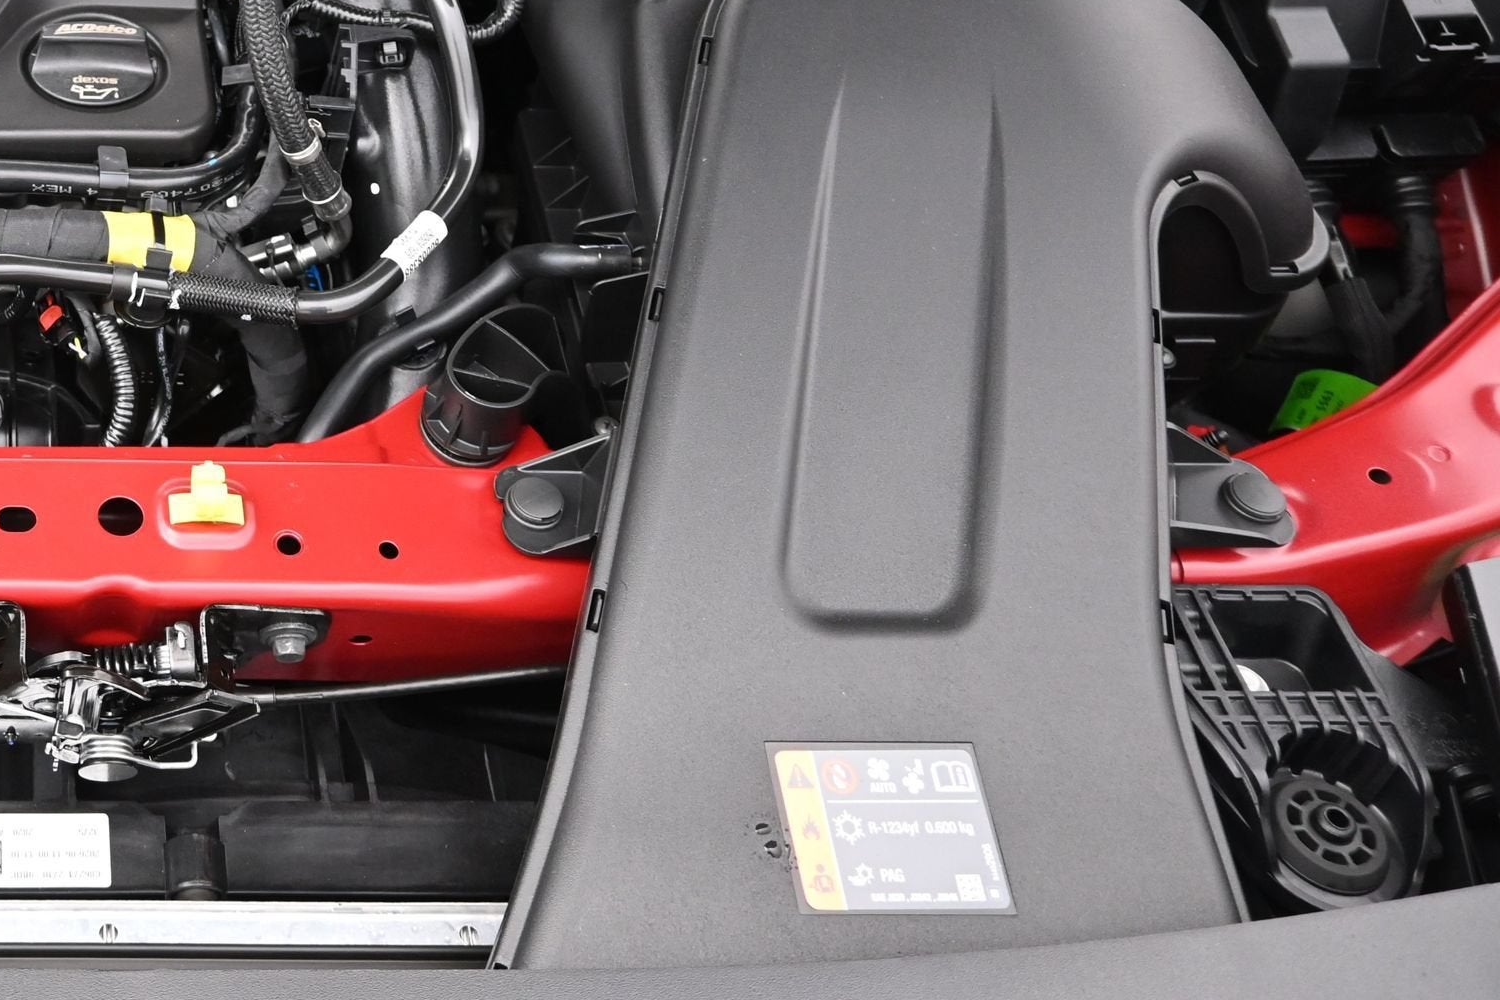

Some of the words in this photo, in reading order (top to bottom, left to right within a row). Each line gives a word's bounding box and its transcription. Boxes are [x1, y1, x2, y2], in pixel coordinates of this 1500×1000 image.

[53, 23, 137, 36] ACDelco
[72, 75, 118, 85] dexos
[32, 182, 73, 195] MEX
[869, 782, 898, 794] AUTO
[959, 820, 976, 837] kg
[879, 867, 907, 884] PAG
